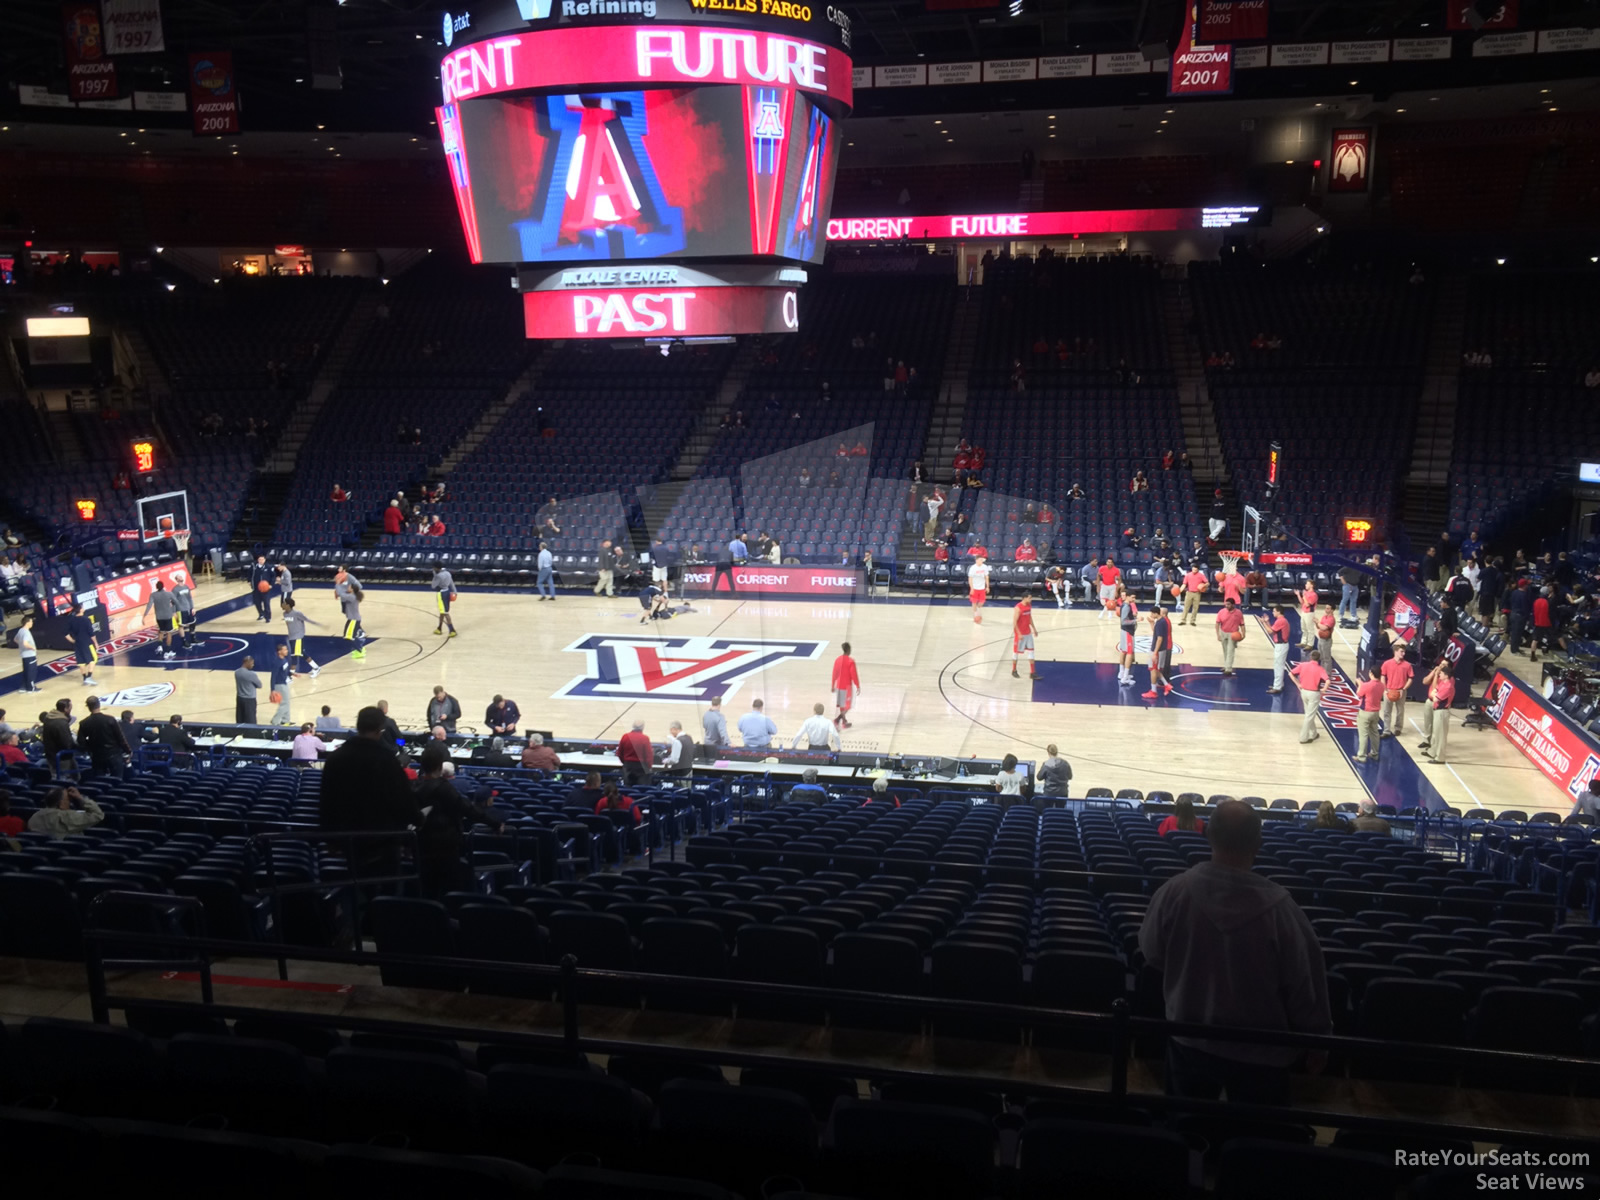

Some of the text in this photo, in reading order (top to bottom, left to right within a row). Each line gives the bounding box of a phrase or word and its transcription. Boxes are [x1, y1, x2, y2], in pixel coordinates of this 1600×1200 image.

[562, 0, 657, 17] Refining
[691, 0, 812, 21] WELLS FARGO
[106, 9, 158, 24] ARIZONA
[453, 11, 471, 33] at&t
[1205, 14, 1231, 24] 2005
[115, 31, 152, 47] 1997
[636, 30, 827, 92] FUTURE
[1176, 52, 1228, 64] ARIZONA
[71, 62, 114, 74] ARIZONA
[1180, 70, 1218, 85] 2001
[79, 80, 109, 94] 1997
[196, 102, 235, 113] ARIZONA
[202, 117, 230, 130] 2001
[752, 102, 784, 139] A
[509, 88, 687, 262] A
[826, 215, 1028, 239] CURRENT FUTURE
[620, 269, 679, 283] CENTER
[573, 292, 696, 333] PAST
[138, 454, 152, 471] 30
[1351, 530, 1365, 541] 30
[684, 573, 856, 587] PAST CURRENT FUTURE
[1506, 711, 1570, 774] DESERT DIAMOND
